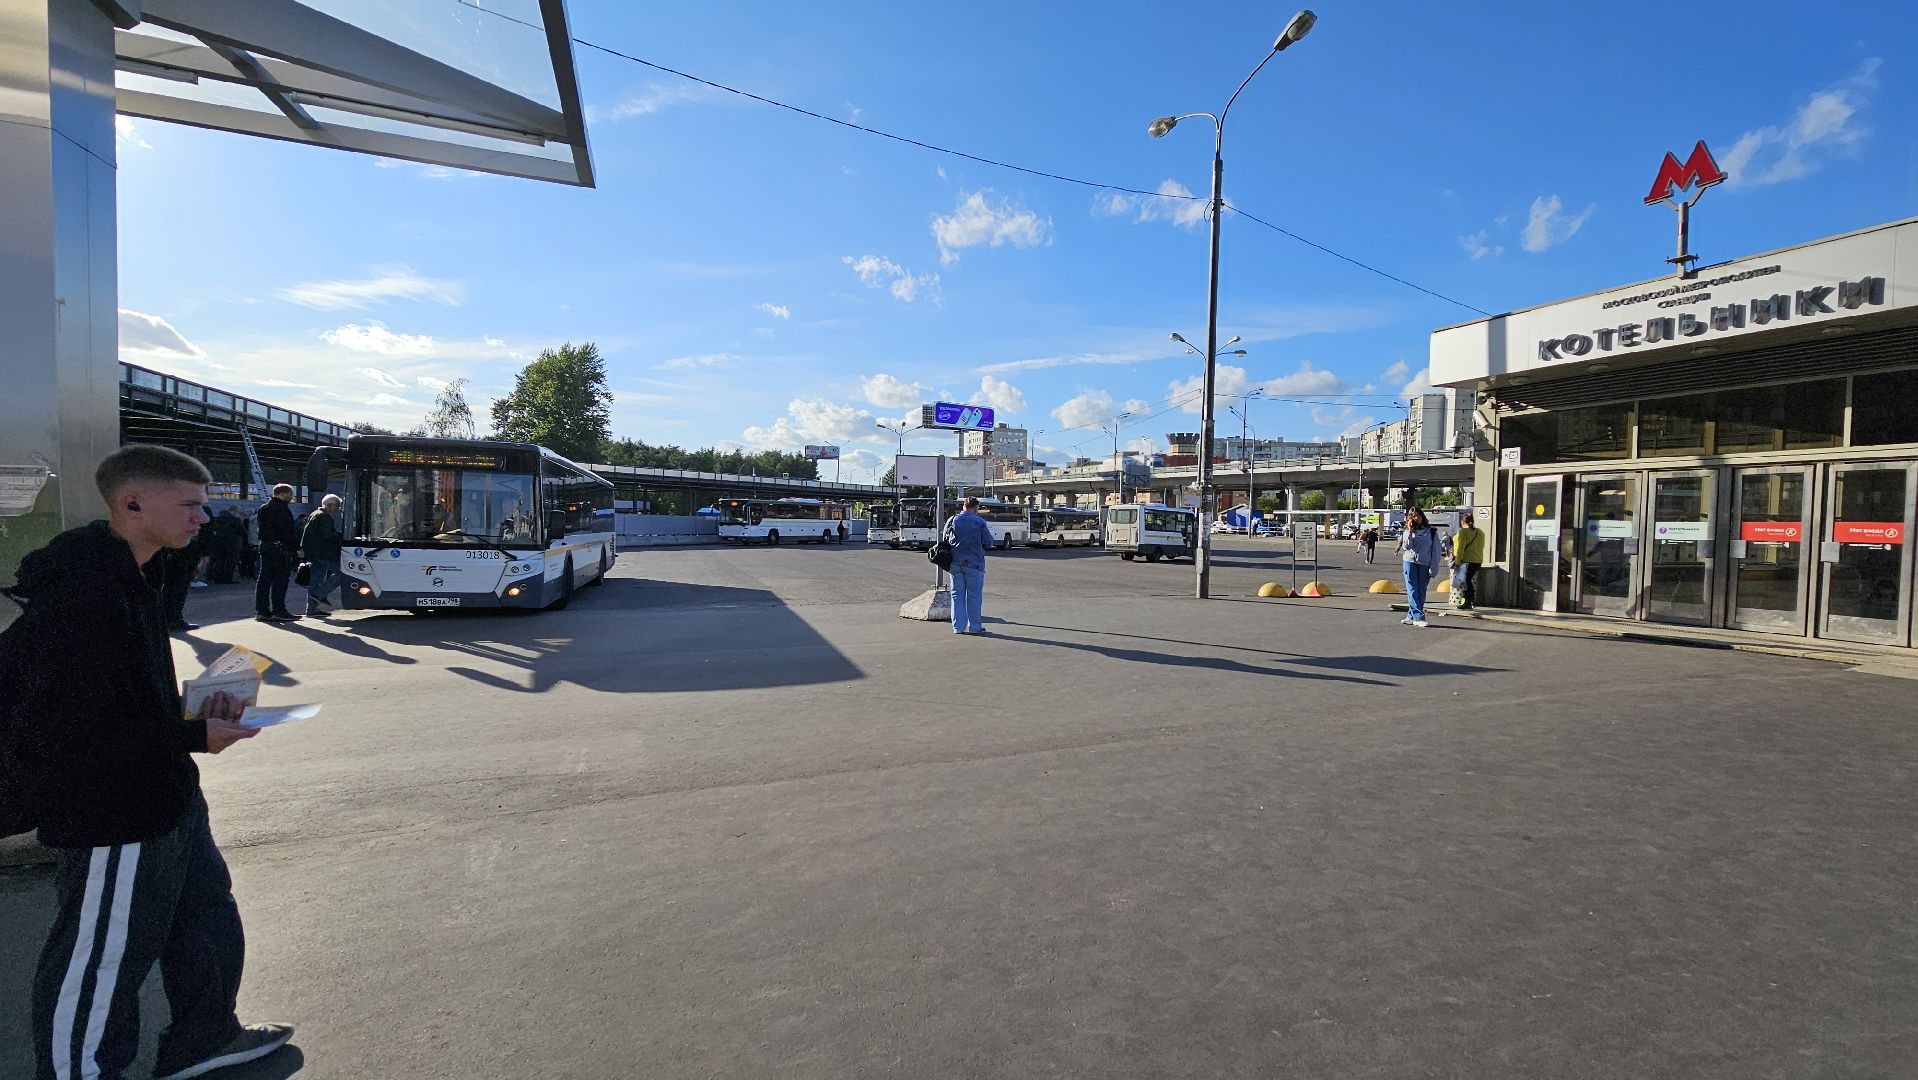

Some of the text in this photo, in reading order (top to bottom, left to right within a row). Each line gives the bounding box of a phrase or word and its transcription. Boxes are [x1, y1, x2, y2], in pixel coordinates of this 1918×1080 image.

[1644, 140, 1728, 204] М
[1538, 276, 1886, 362] КОТЕЛЬНИКИ
[1602, 285, 1680, 309] МОСКОВСКИЙ
[466, 550, 500, 560] 013018
